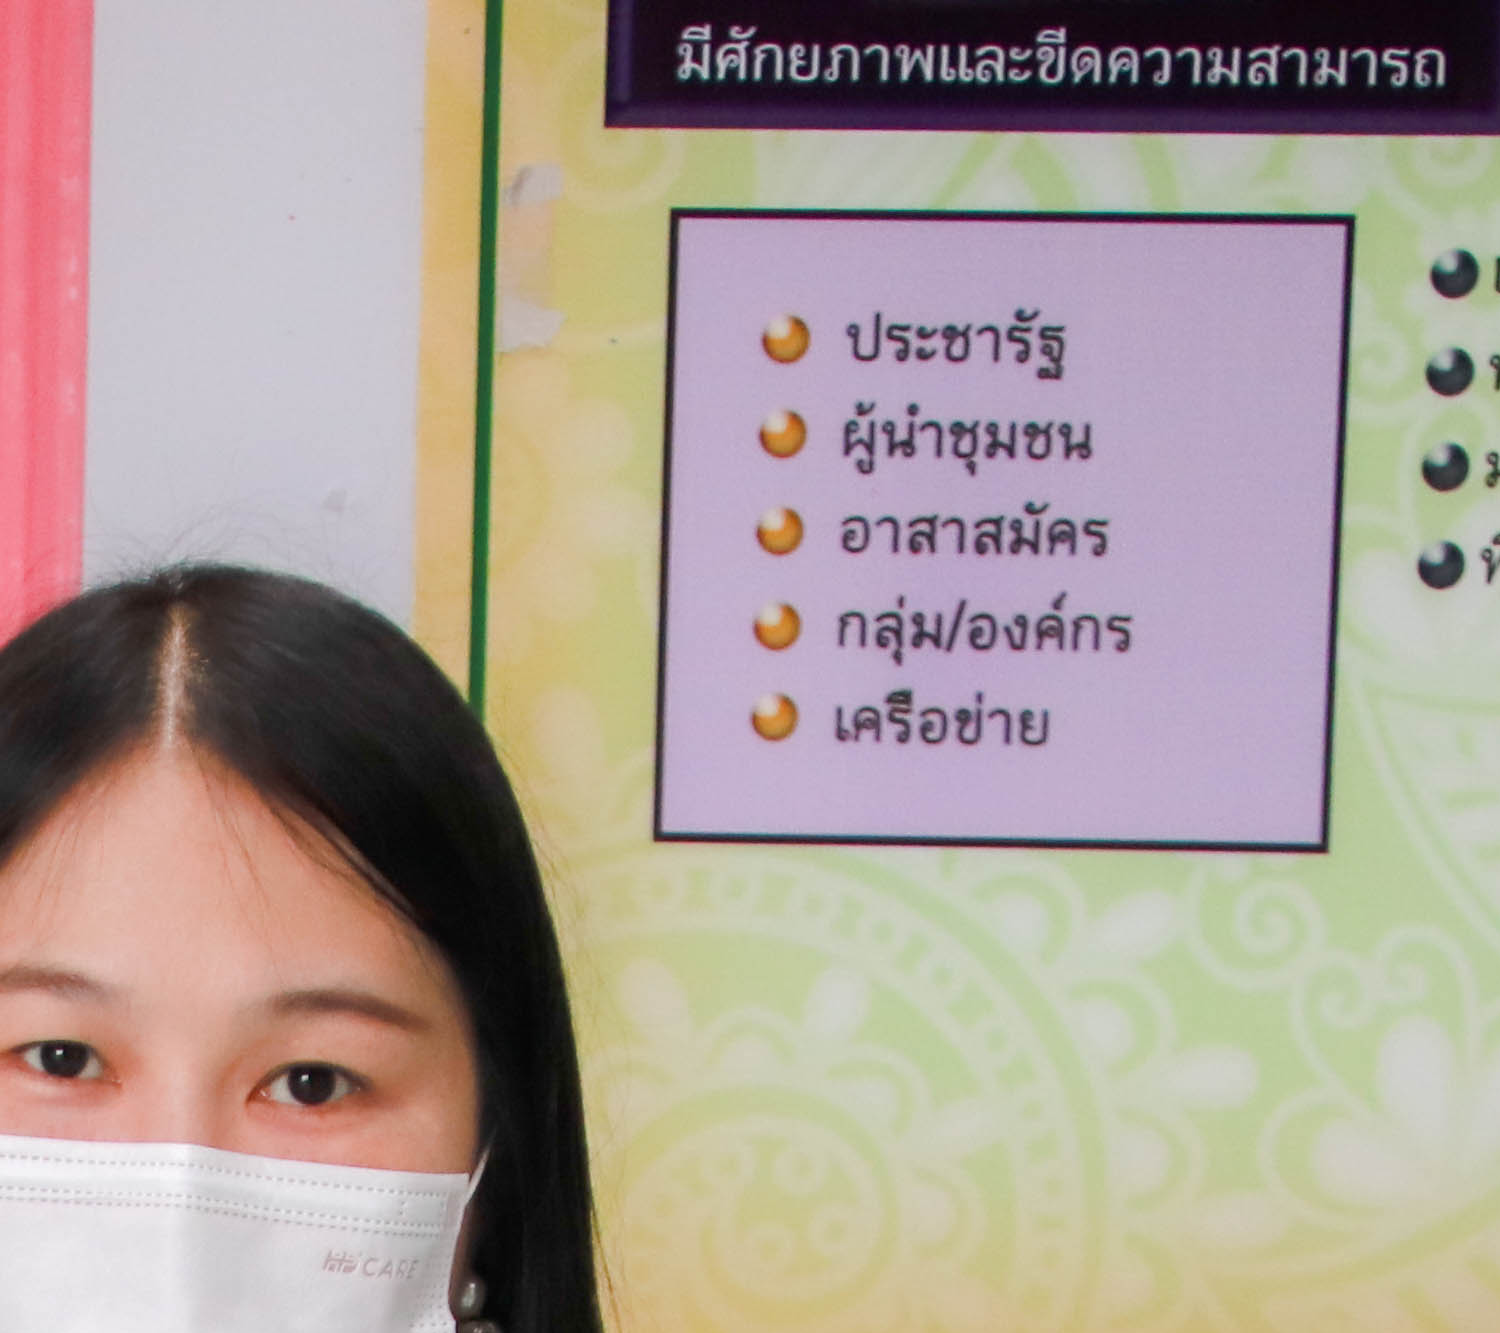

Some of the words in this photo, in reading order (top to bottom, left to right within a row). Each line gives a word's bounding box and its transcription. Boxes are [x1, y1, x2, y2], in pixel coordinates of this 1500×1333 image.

[676, 25, 1446, 87] มีศักยภาพและขีดความสามารถ
[846, 308, 1067, 380] ประชารัฐ
[842, 401, 1093, 477] ผู้นำชุมชน
[840, 501, 1110, 557] อาสาสมัคร
[837, 591, 1134, 666] กลุ่ม/องค์กร
[834, 688, 1050, 746] เครือข่าย
